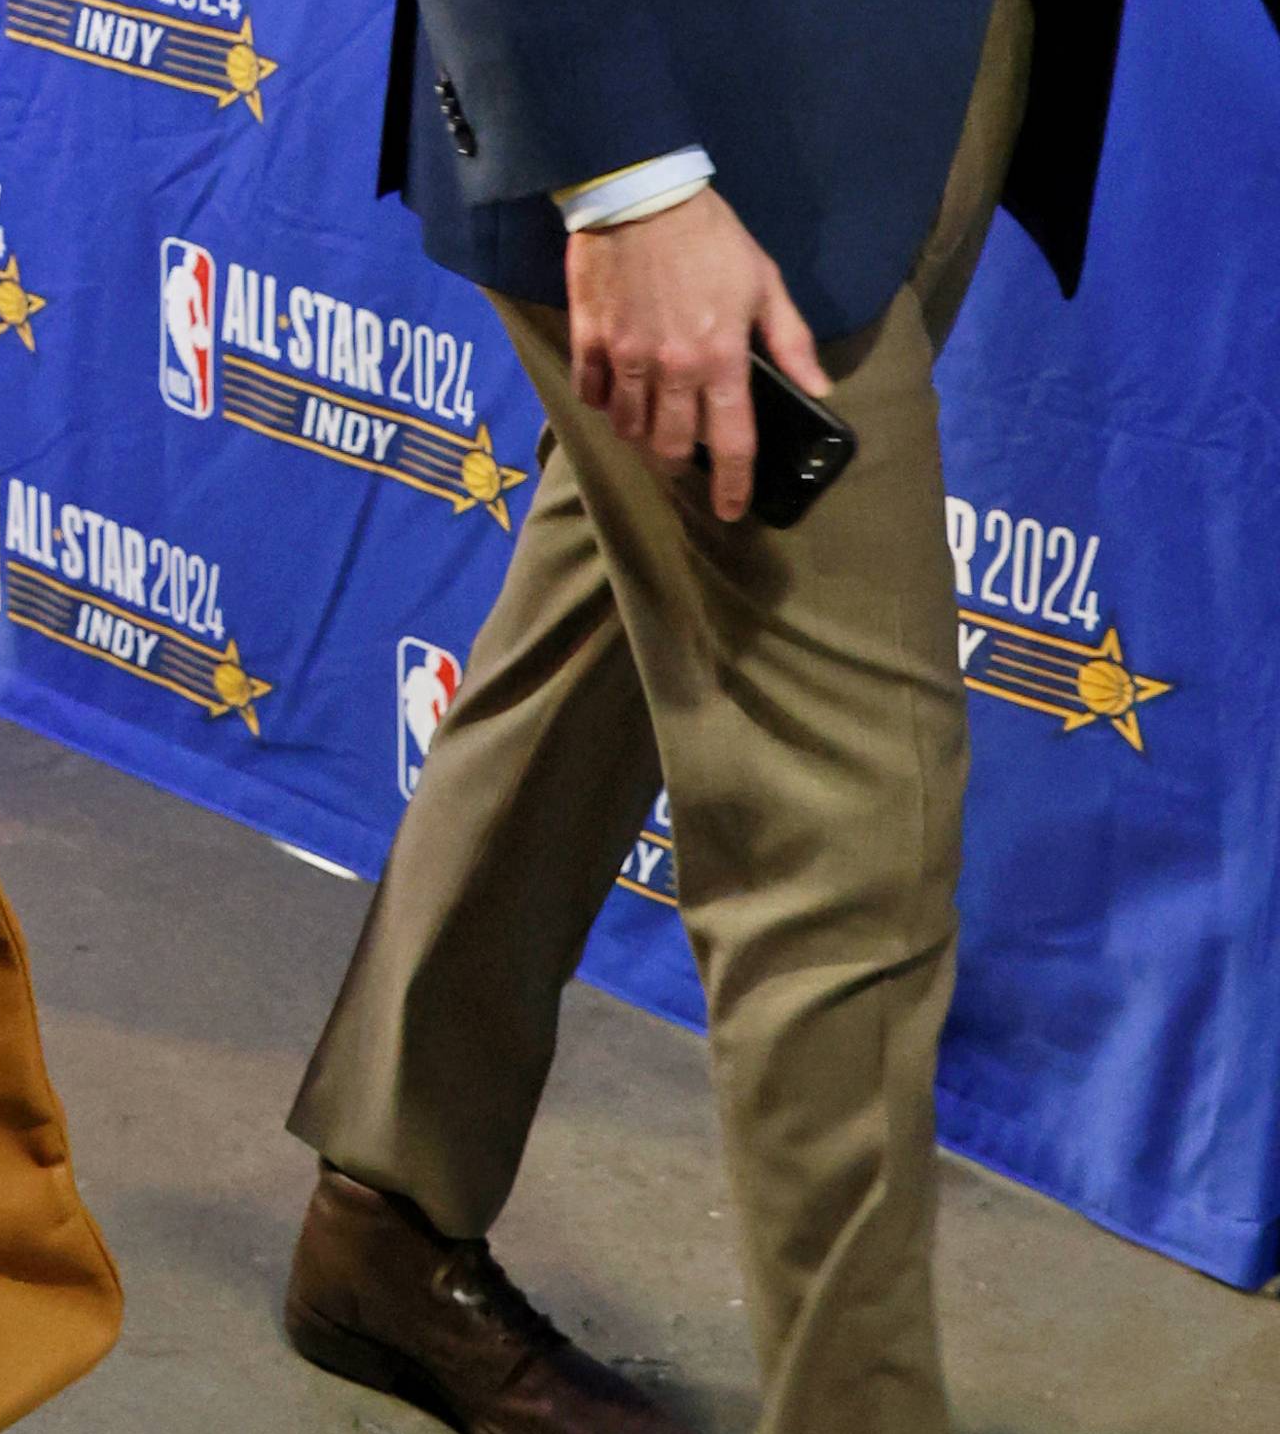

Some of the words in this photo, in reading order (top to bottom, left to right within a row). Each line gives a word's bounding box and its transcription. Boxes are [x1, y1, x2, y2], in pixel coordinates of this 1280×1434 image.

[74, 6, 166, 67] INDY
[387, 317, 476, 428] 2024
[301, 395, 399, 462] INDY
[148, 536, 226, 642] 2024
[980, 508, 1101, 632] 2024
[76, 602, 160, 669] INDY
